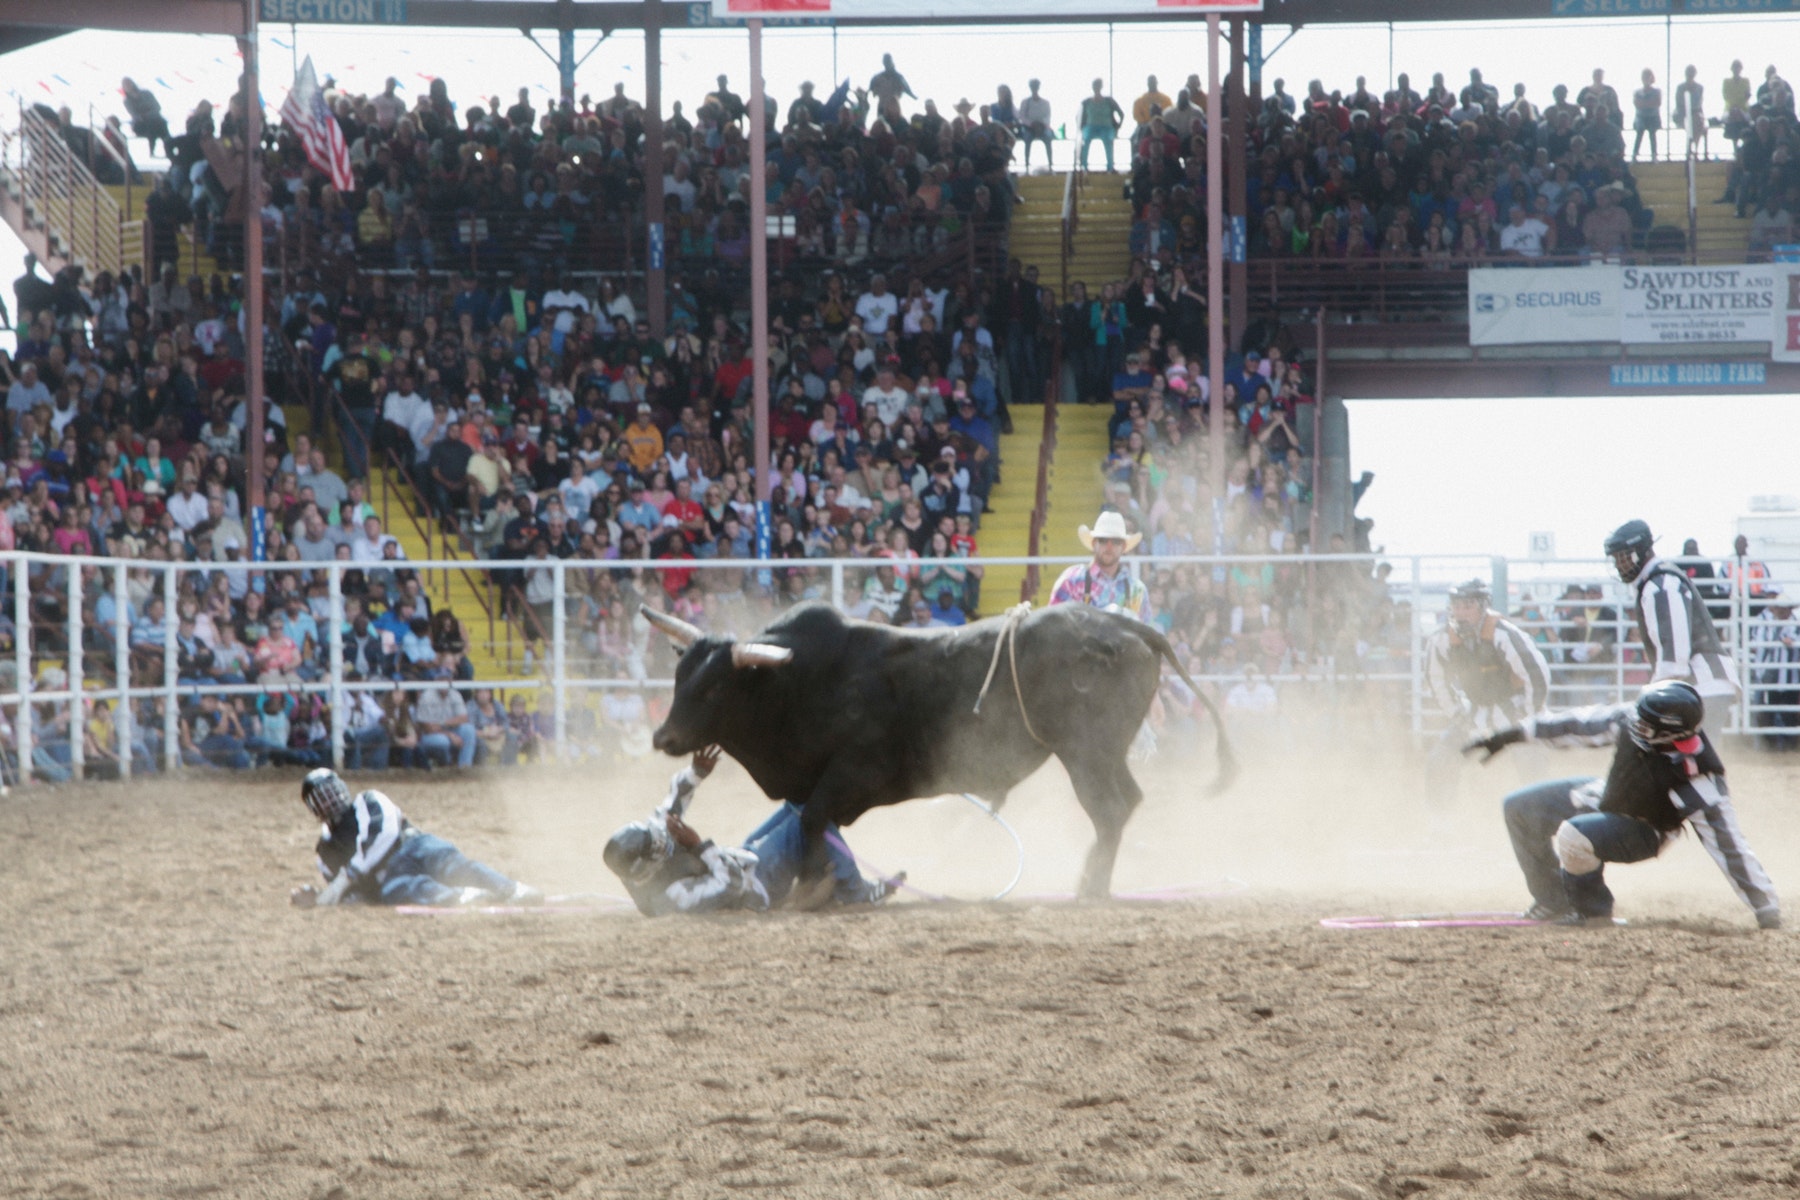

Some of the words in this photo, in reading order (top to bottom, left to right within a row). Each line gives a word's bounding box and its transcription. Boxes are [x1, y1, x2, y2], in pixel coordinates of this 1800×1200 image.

[263, 0, 374, 21] SECTION
[1623, 268, 1740, 290] SAWDUST
[1745, 277, 1774, 287] AND
[1516, 291, 1602, 308] SECURUS
[1645, 289, 1774, 310] SPLINTERS
[1612, 364, 1669, 384] THANKS
[1677, 362, 1722, 383] RODEO
[1729, 362, 1766, 383] FANS
